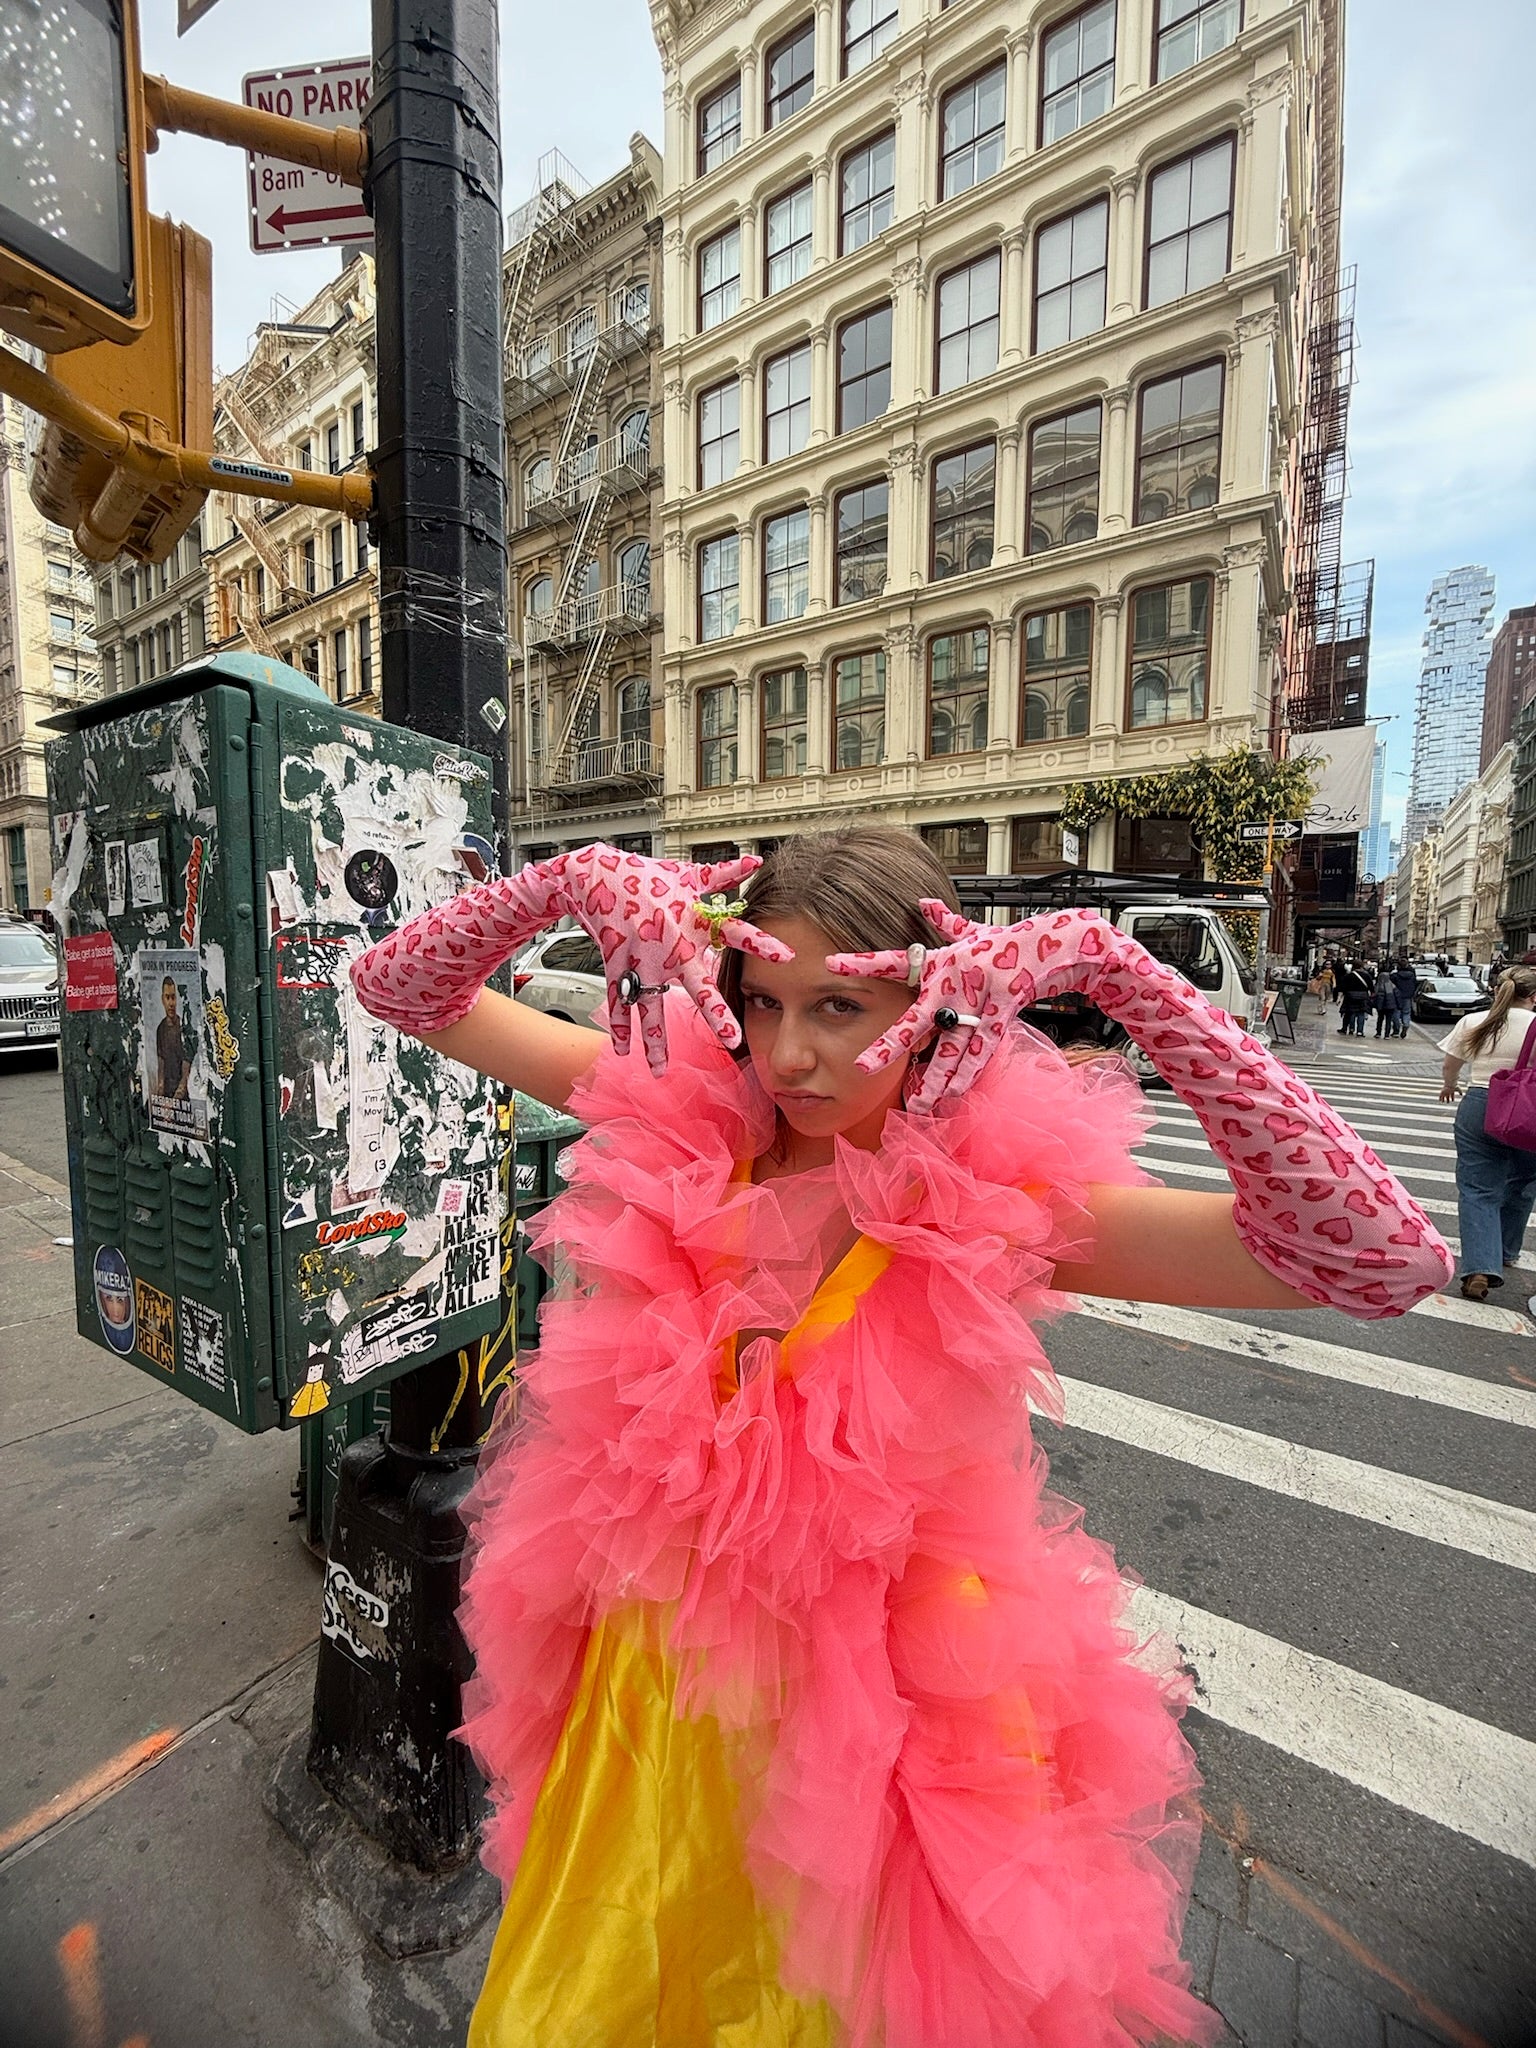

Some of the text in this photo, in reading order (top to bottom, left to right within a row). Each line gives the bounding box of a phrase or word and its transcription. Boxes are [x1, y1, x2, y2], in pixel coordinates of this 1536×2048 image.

[258, 88, 293, 117] NO
[262, 168, 304, 192] 8am
[211, 459, 290, 483] @urhuman
[1248, 825, 1294, 837] ONE WAY
[81, 947, 91, 962] get
[95, 944, 113, 958] tissue
[142, 960, 198, 973] WORK IN PROGRESS
[84, 984, 95, 999] get
[100, 982, 117, 995] tissue
[317, 1209, 408, 1246] LordSko
[444, 1258, 490, 1293] TKE
[181, 1294, 197, 1308] KAFKA
[138, 1326, 174, 1370] RELICS
[184, 1363, 200, 1378] KAFKA
